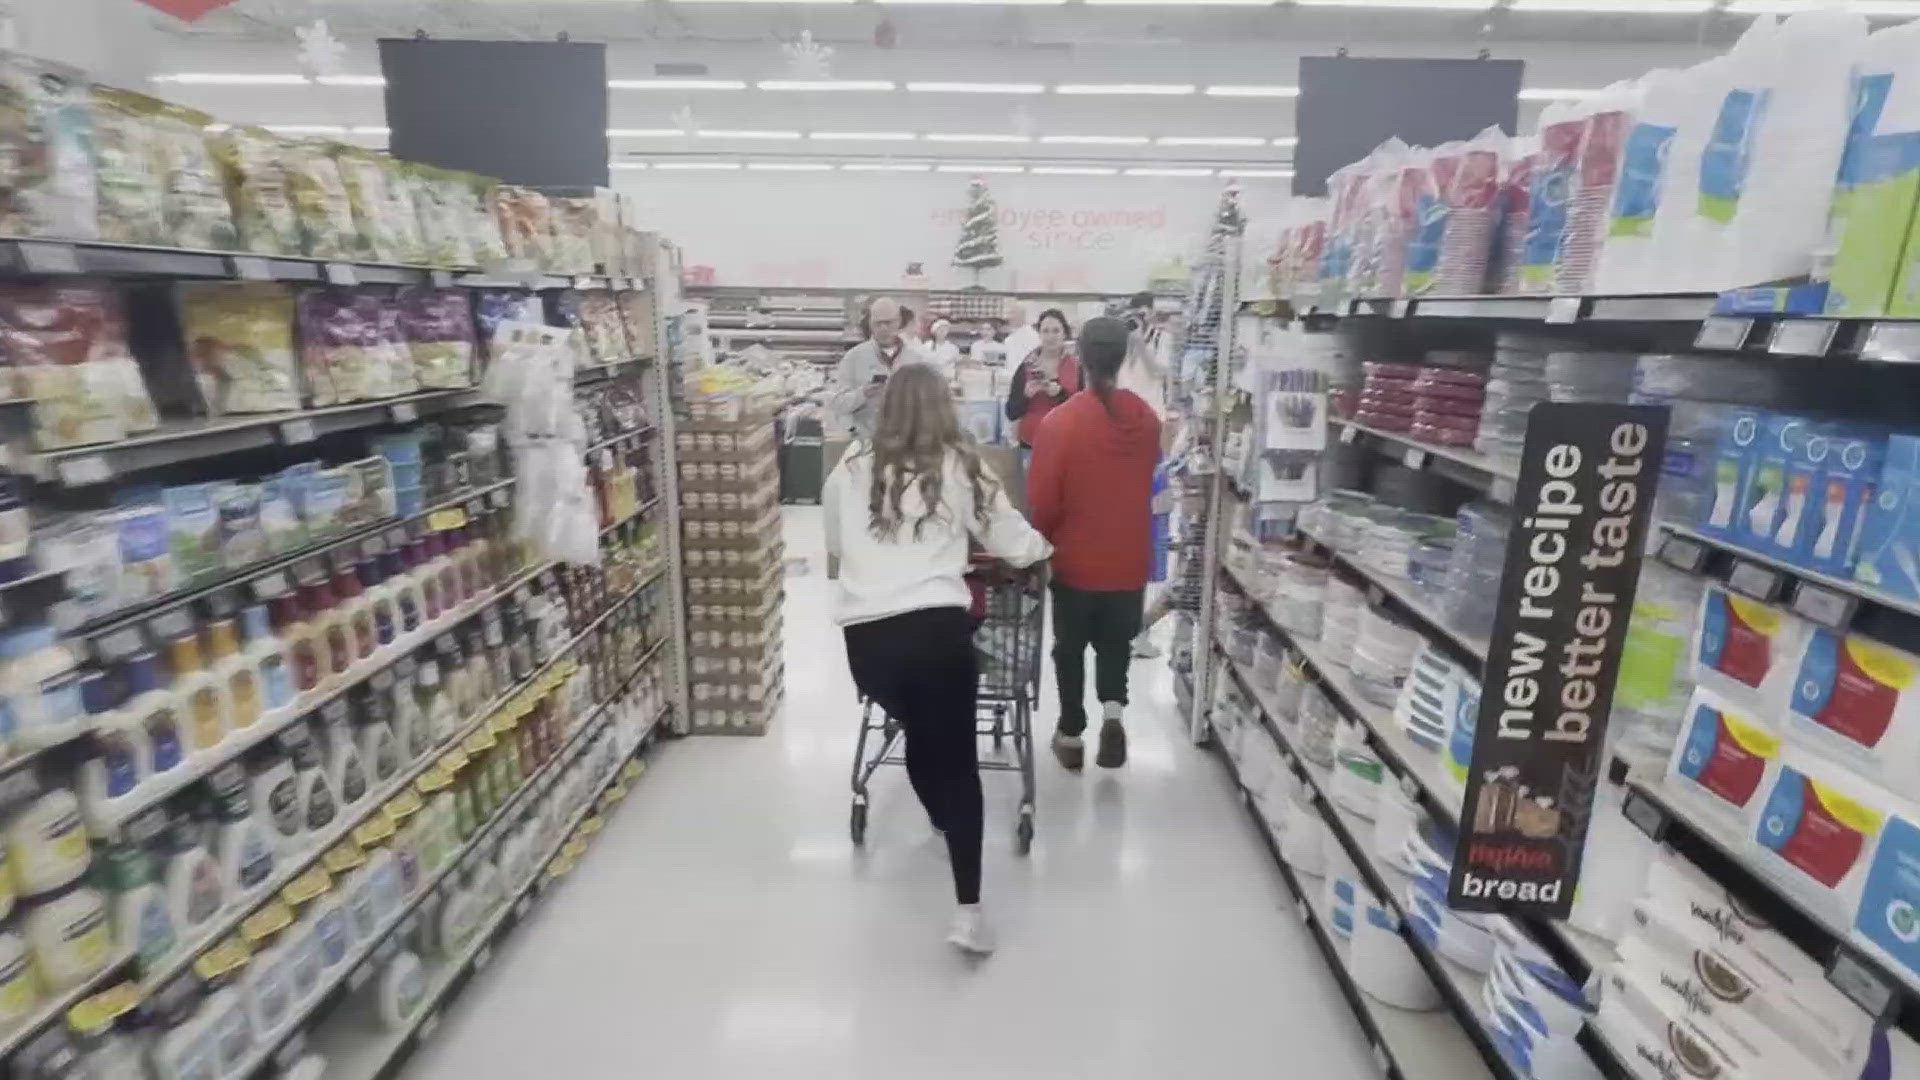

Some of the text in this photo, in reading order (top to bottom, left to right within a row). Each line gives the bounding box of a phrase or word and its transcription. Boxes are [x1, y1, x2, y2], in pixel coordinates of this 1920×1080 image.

[1072, 204, 1166, 229] owned
[1028, 226, 1115, 250] since
[1498, 444, 1583, 740] new recipe
[1544, 422, 1648, 744] better taste
[1461, 873, 1561, 903] bread
